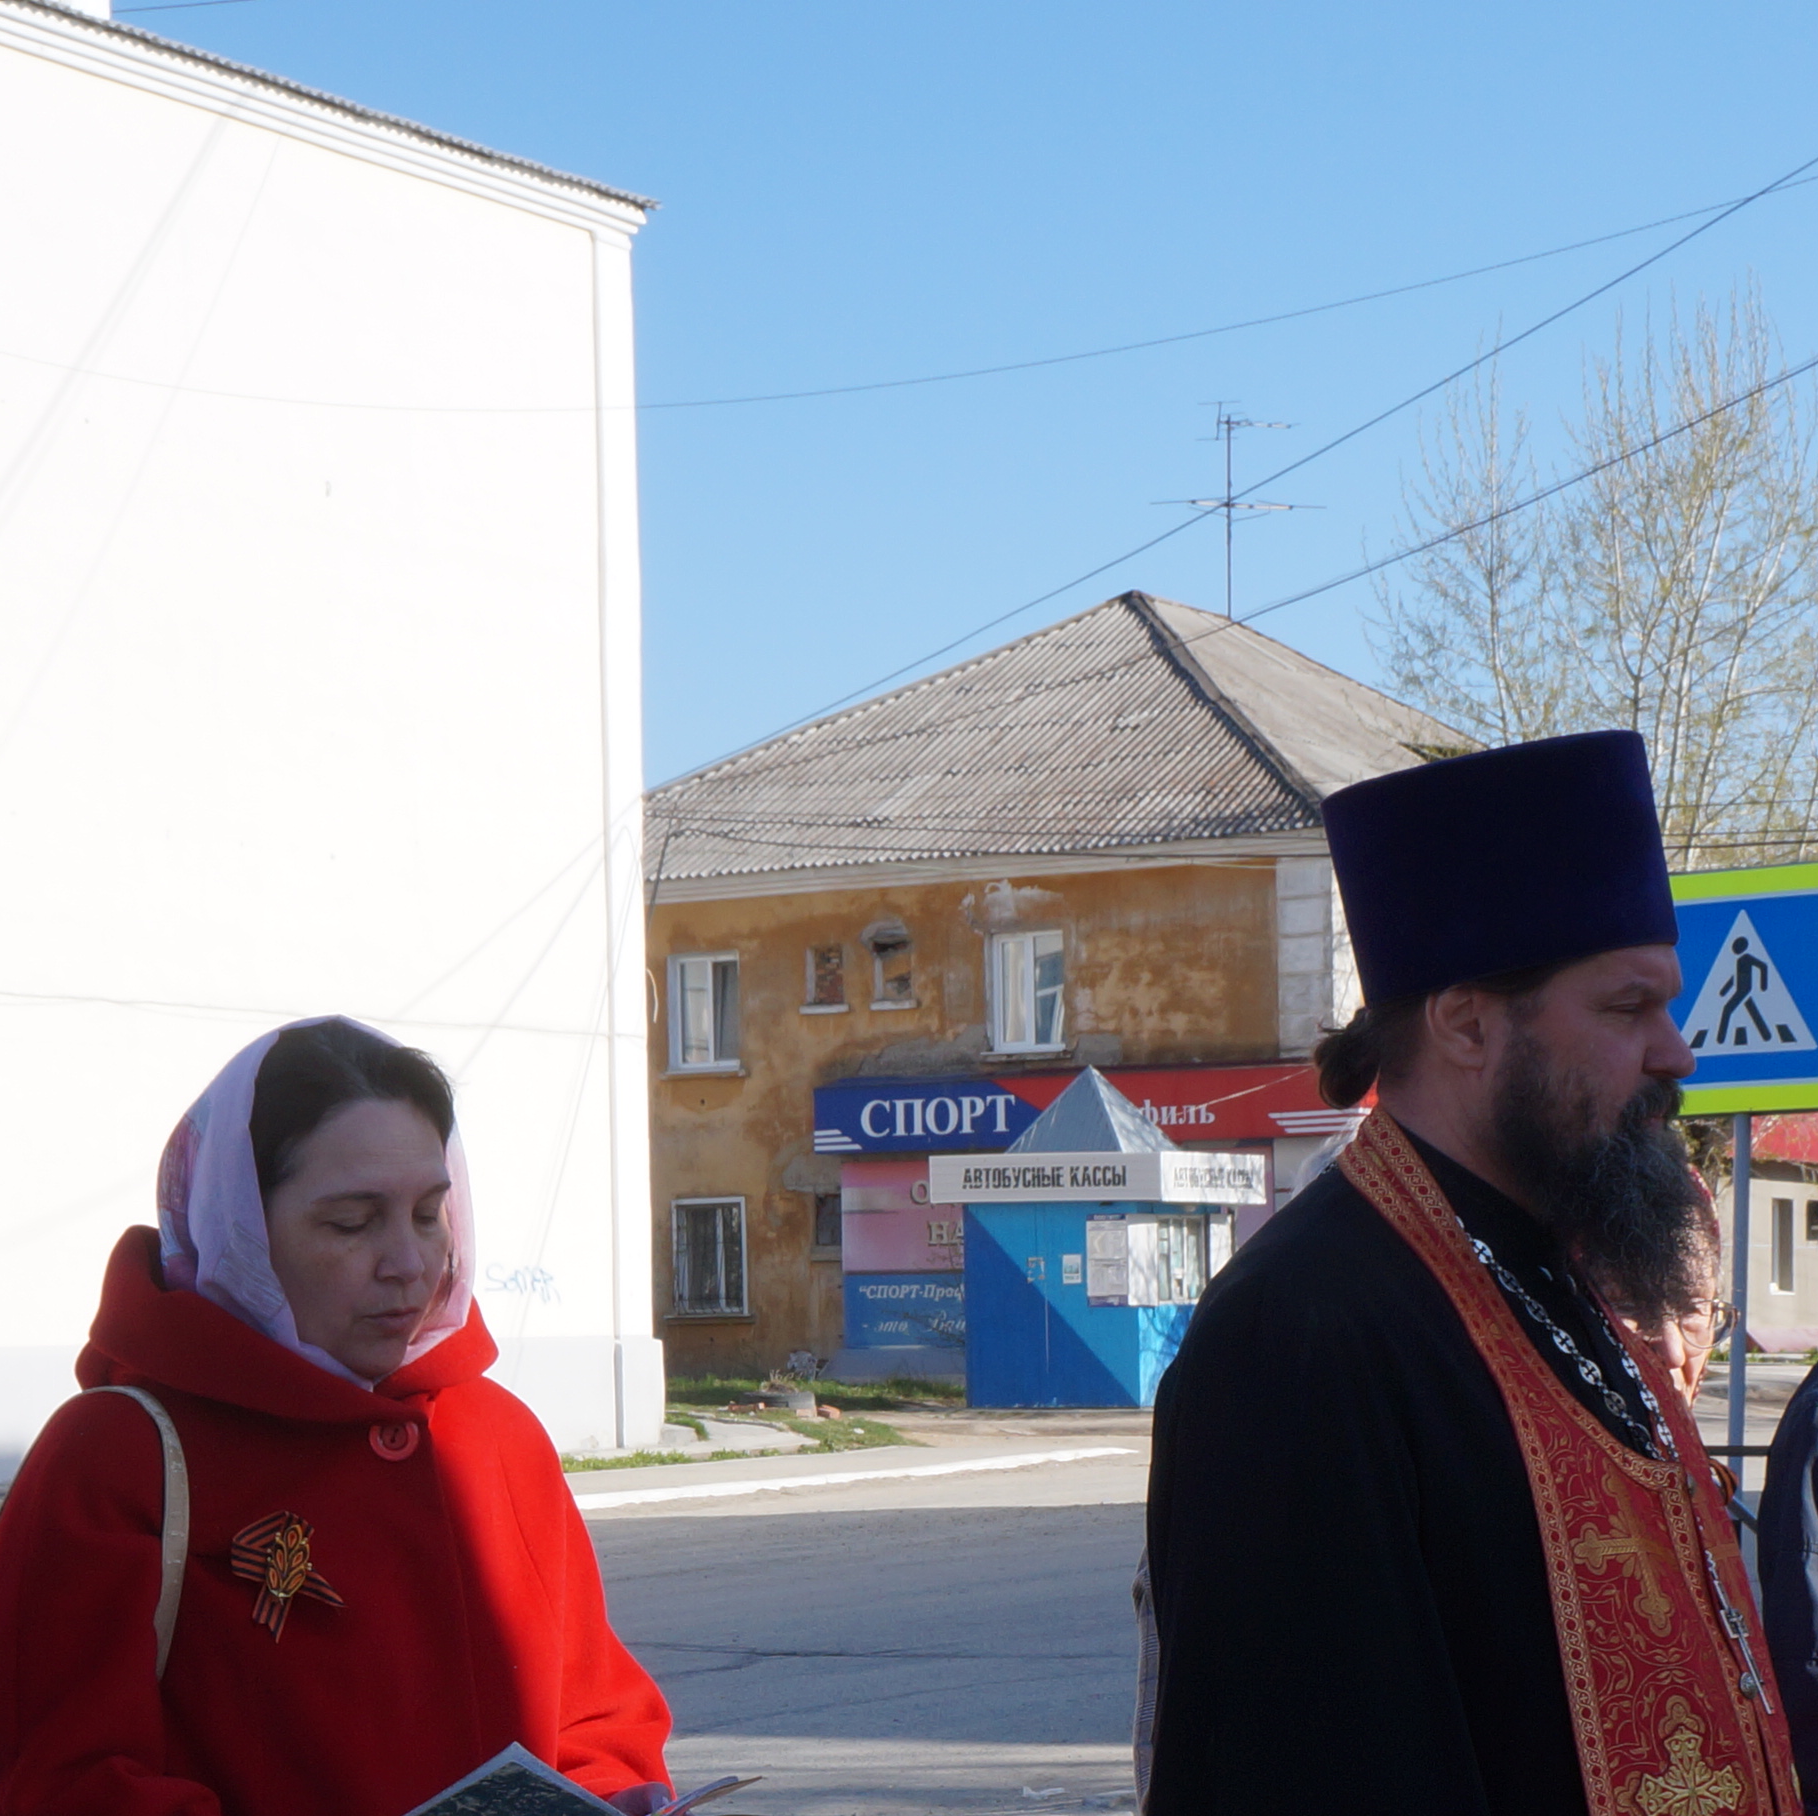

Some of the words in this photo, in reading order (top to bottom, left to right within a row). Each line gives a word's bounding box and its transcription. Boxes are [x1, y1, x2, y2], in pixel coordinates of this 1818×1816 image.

[860, 1094, 1015, 1137] СПОРТ
[1138, 1098, 1215, 1126] филь
[962, 1165, 1064, 1190] АВТОБУСНЫЕ
[1069, 1164, 1127, 1188] КАССЫ
